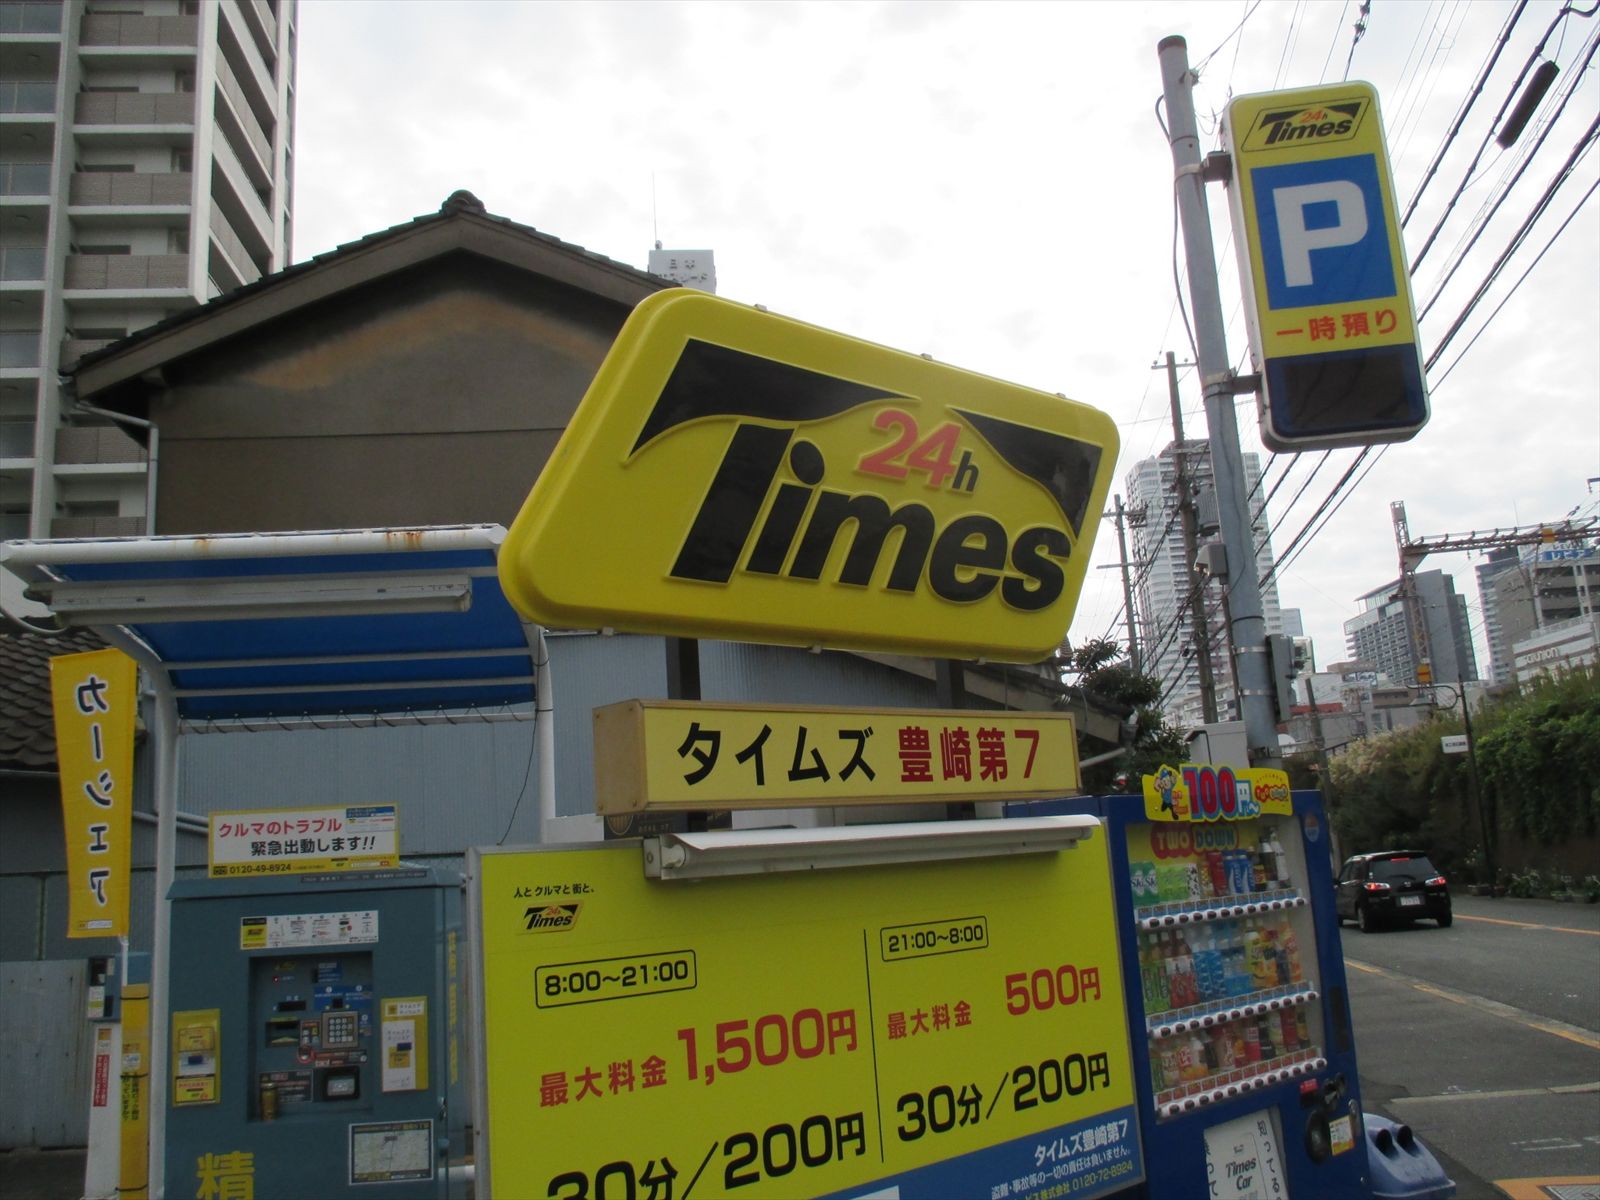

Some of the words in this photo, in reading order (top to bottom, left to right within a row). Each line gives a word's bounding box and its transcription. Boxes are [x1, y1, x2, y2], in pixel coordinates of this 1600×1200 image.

[1265, 114, 1353, 145] Times
[1300, 110, 1328, 123] 24h
[1273, 180, 1368, 288] P
[1276, 308, 1398, 341] 一時預り
[857, 410, 980, 494] 24h
[667, 421, 1073, 612] Times
[219, 817, 342, 838] クルマのトラブル
[1155, 830, 1190, 851] TWO
[251, 836, 376, 857] 緊急出動します!!
[526, 911, 573, 931] Times
[888, 1000, 972, 1040] 最大料金
[1005, 964, 1102, 1016] 500円
[539, 1054, 667, 1108] 最大料金
[677, 1007, 858, 1086] 1,500円
[1034, 1118, 1128, 1168] タイムズ豊崎第7
[1225, 1157, 1257, 1178] Times
[1236, 1175, 1253, 1191] Car
